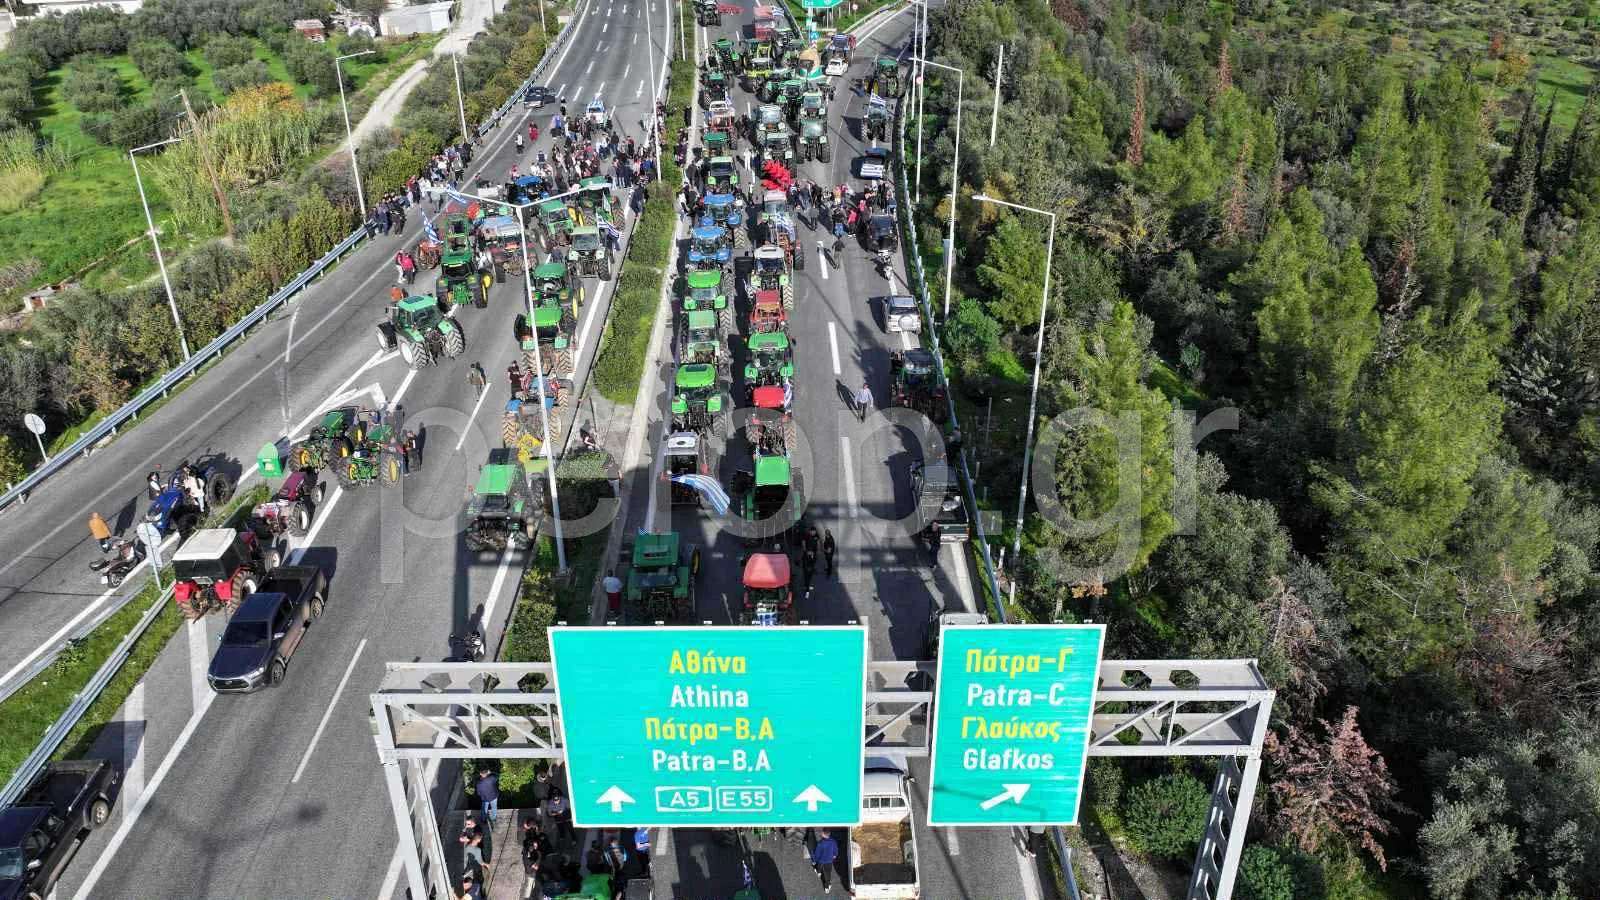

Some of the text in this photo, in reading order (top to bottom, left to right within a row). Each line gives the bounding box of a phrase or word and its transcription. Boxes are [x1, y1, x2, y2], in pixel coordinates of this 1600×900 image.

[669, 649, 747, 674] Αθήνα
[966, 648, 1073, 680] Πάτρα-Γ
[671, 684, 749, 708] Athina
[967, 682, 1066, 706] Patra-C
[961, 716, 1062, 742] Γλαύκος
[652, 749, 771, 772] Patra-B.A
[963, 748, 1054, 770] Glafkos
[671, 791, 699, 807] A5
